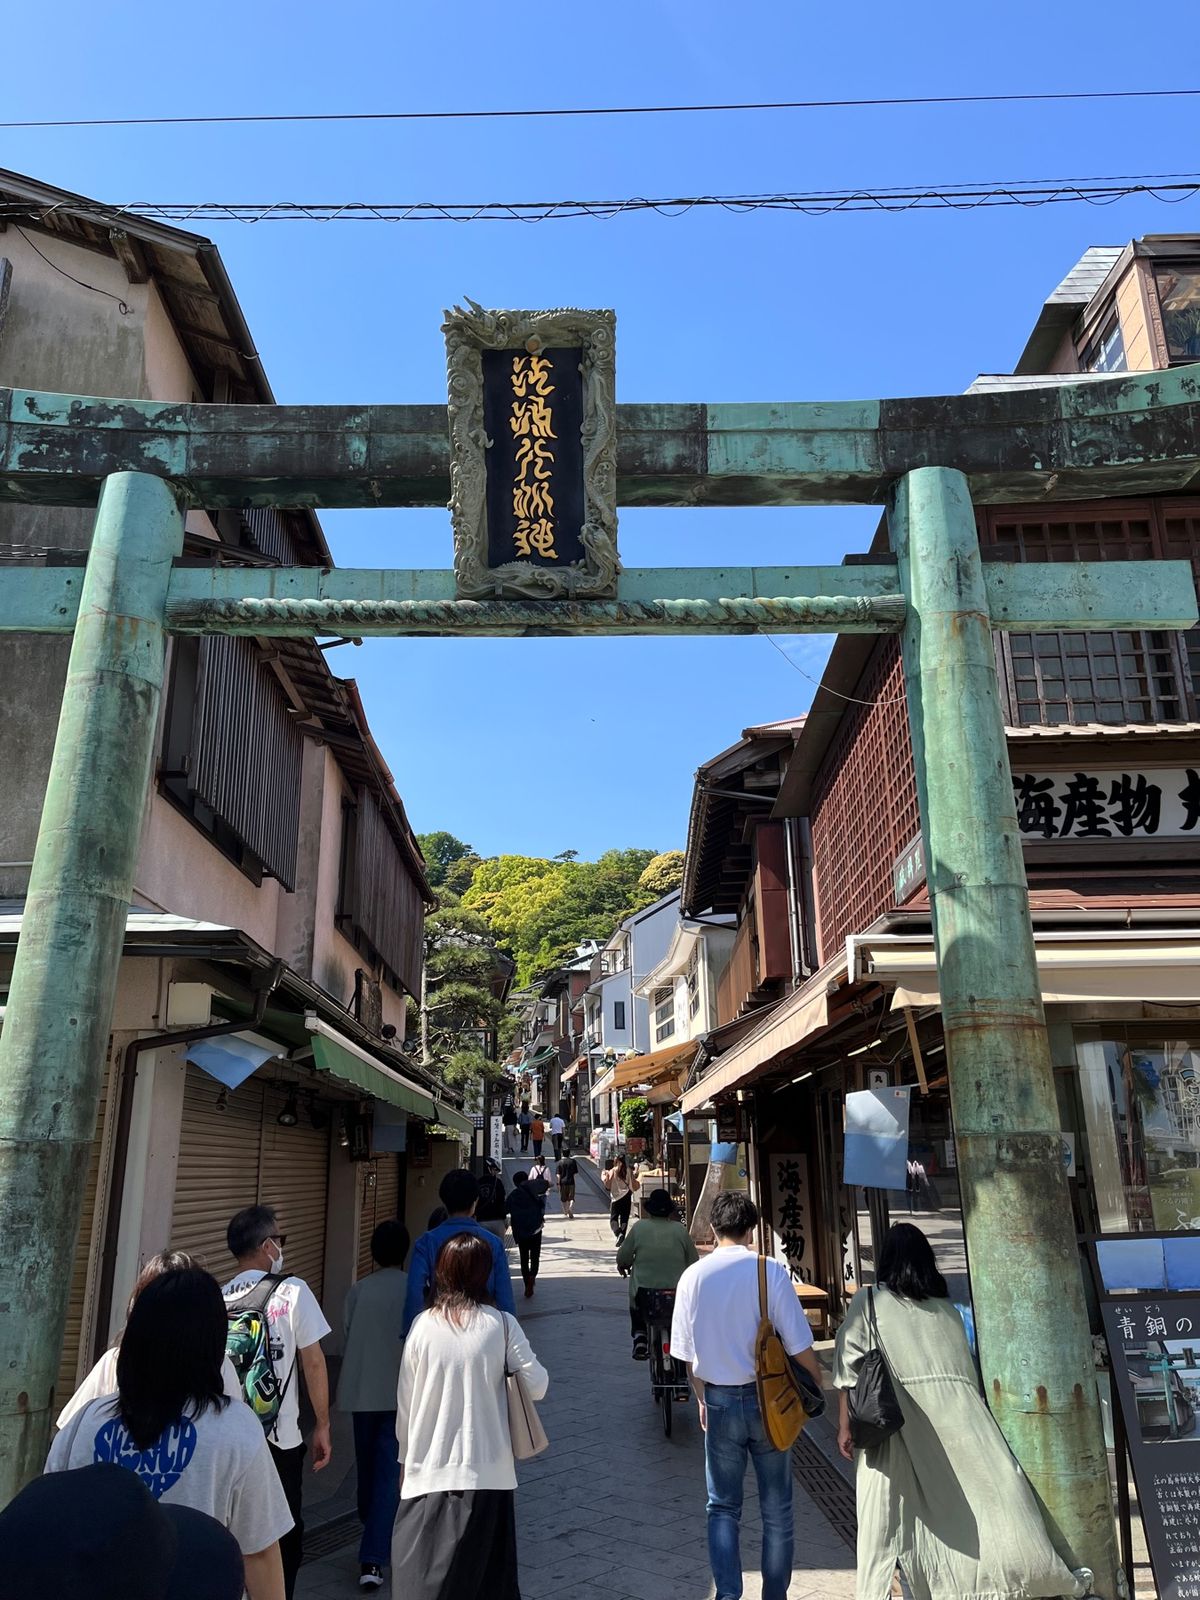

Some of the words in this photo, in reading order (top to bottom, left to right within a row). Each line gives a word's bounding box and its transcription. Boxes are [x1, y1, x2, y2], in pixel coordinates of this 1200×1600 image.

[777, 1159, 806, 1262] 海産物
[1117, 1315, 1193, 1340] 青銅の
